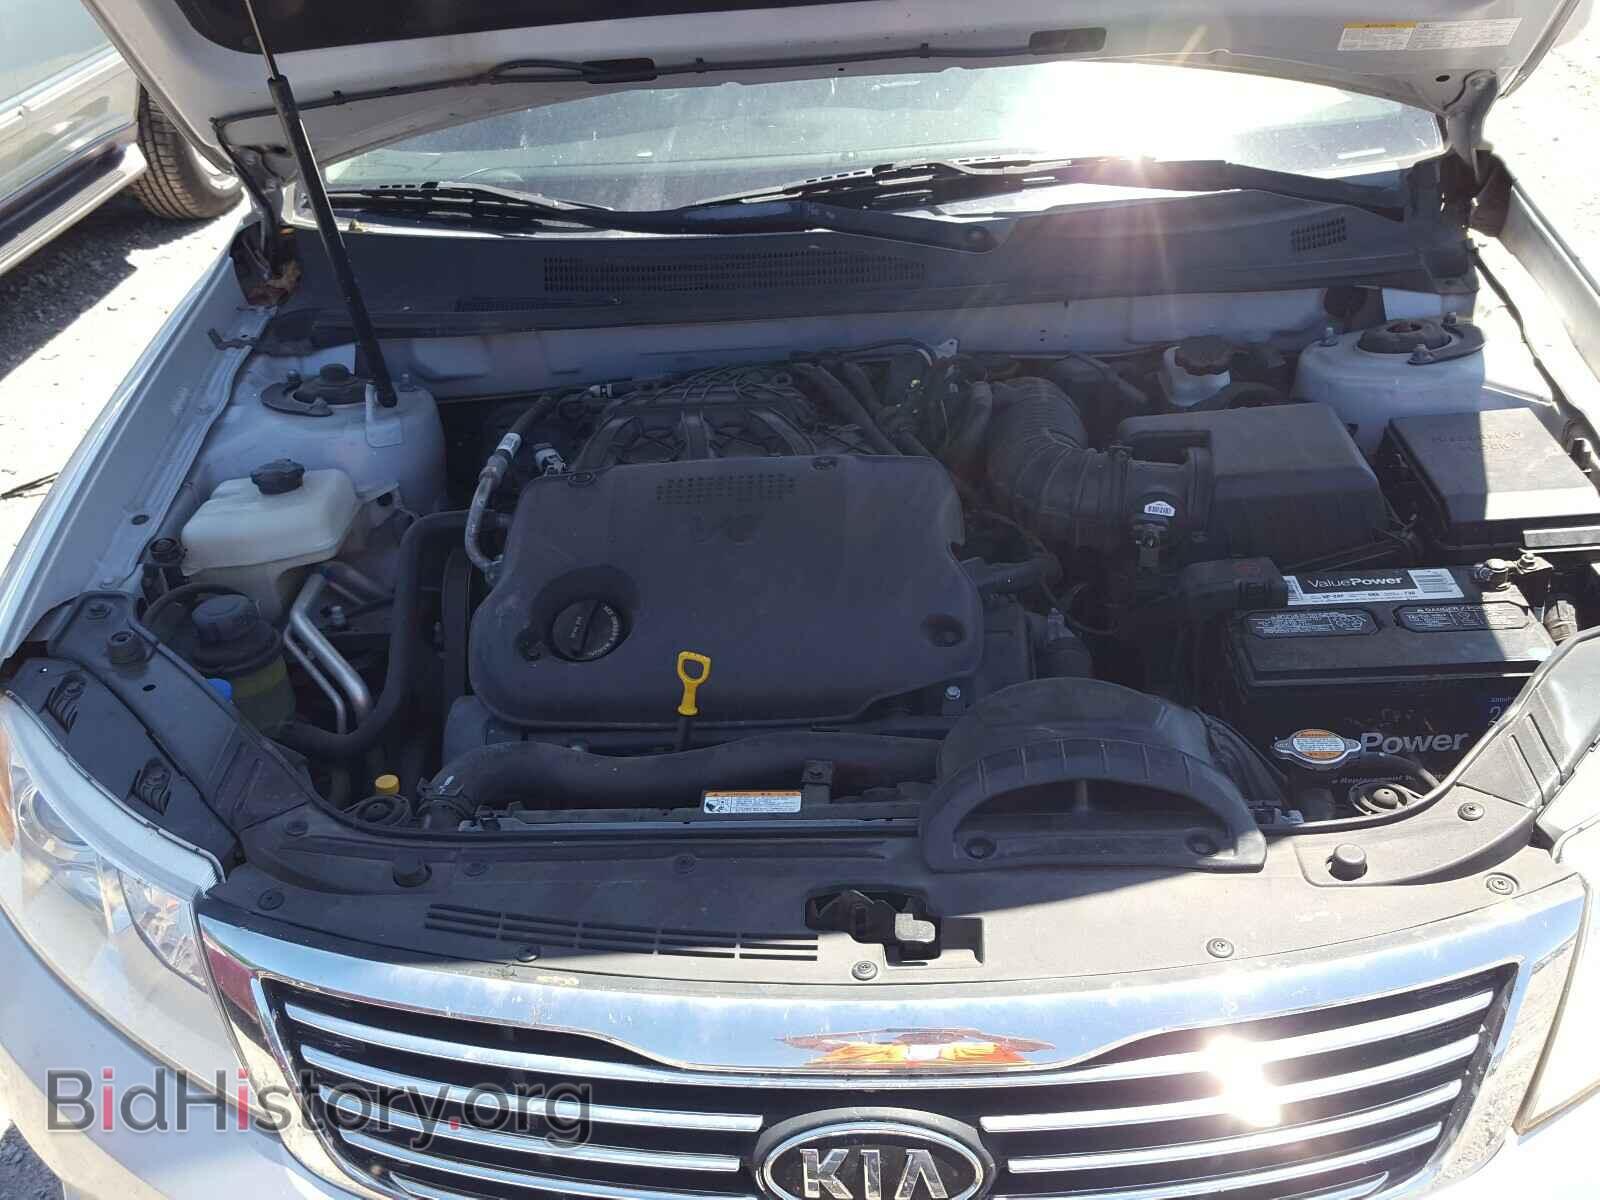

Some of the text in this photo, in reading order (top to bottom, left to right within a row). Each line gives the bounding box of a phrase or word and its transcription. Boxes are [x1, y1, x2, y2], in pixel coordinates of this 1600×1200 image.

[1307, 577, 1403, 588] ValuePower
[1360, 732, 1470, 753] Power
[799, 1148, 950, 1199] KIA
